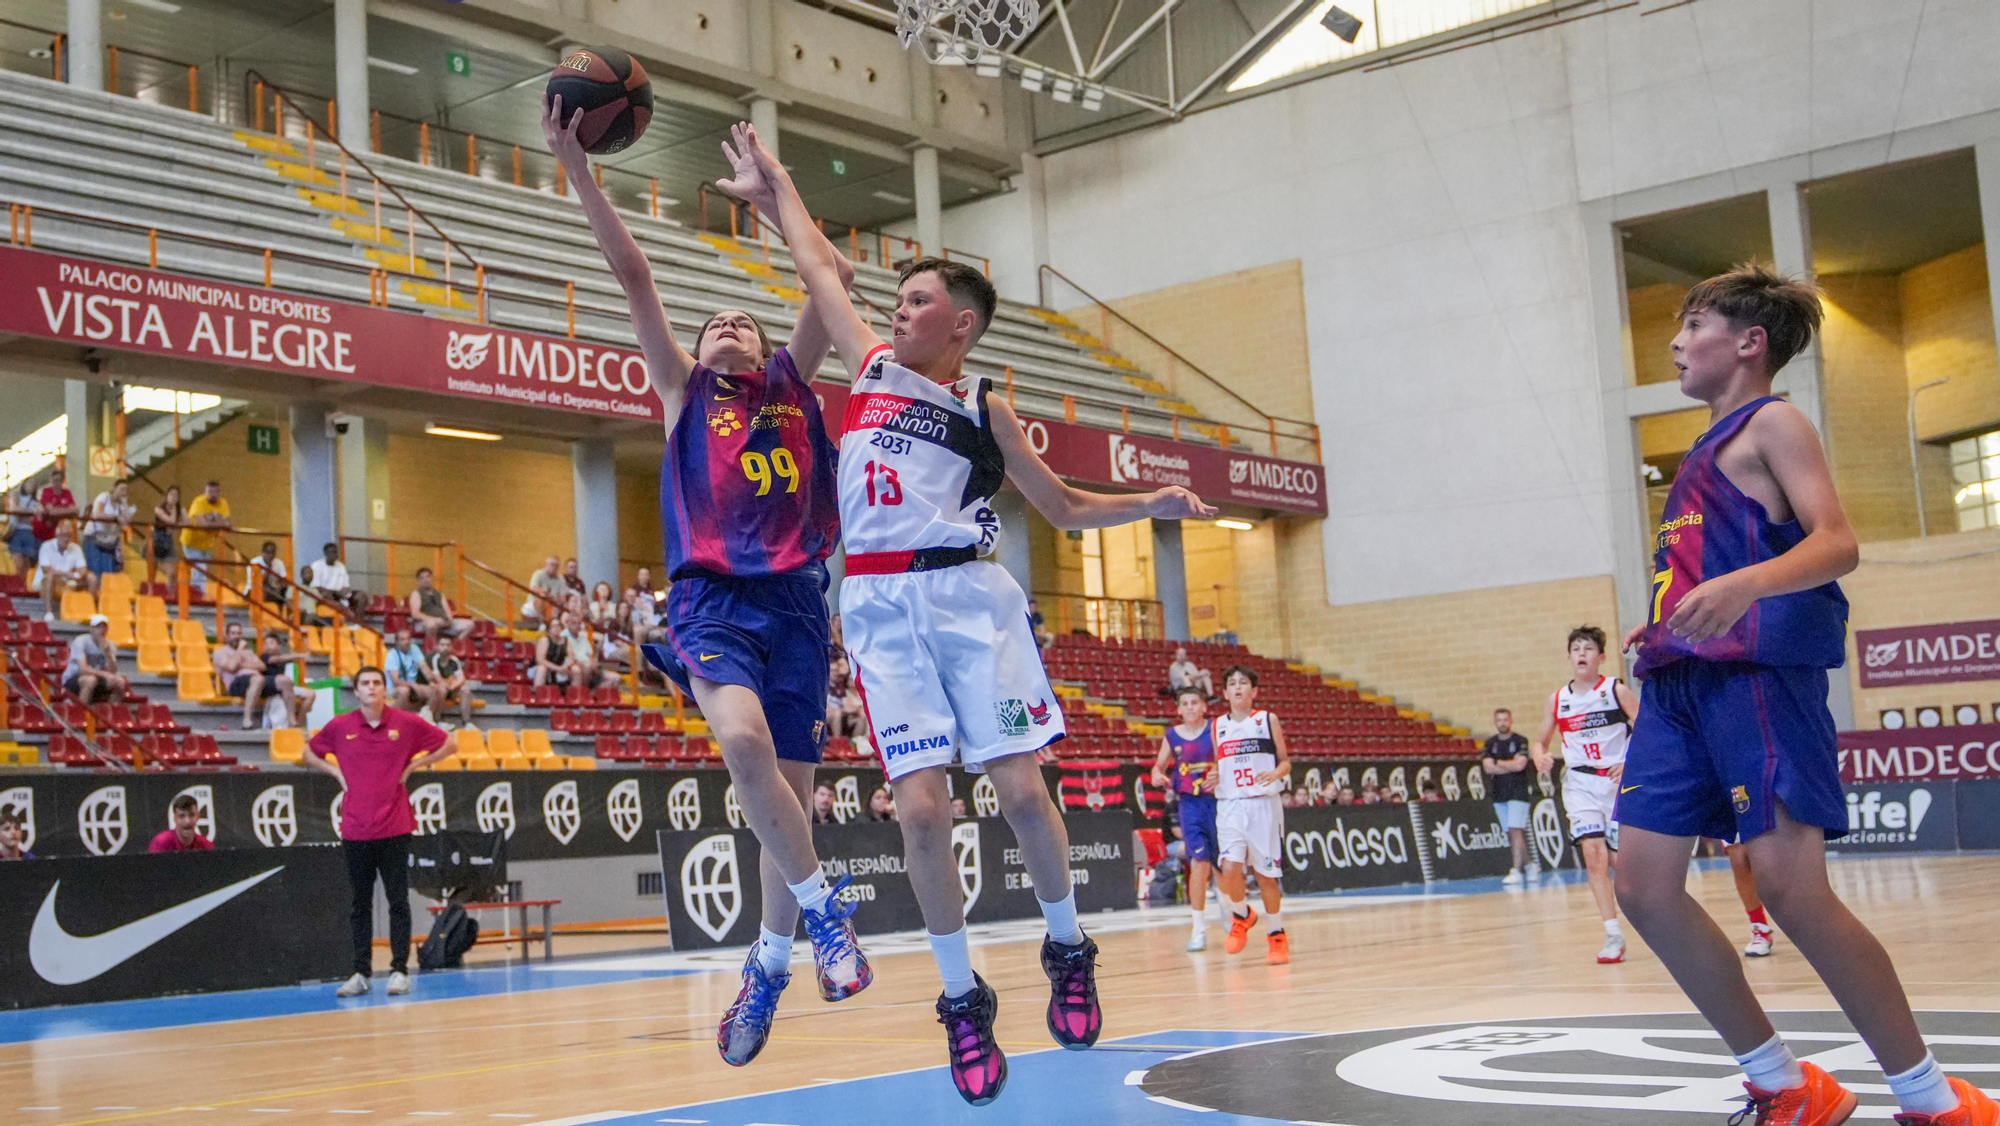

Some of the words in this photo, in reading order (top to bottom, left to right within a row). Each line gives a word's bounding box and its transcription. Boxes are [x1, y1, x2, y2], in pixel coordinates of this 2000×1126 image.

[453, 56, 464, 72] 9
[833, 160, 846, 174] 10
[59, 263, 143, 293] PALACIO
[147, 278, 244, 310] MUNICIPAL
[249, 294, 331, 323] DEPORTES
[37, 286, 173, 349] VISTA
[187, 311, 356, 373] ALEGRE
[496, 334, 651, 395] IMDECO
[447, 377, 493, 395] Instituto
[495, 383, 547, 403] Municipal
[548, 391, 562, 405] de
[563, 392, 609, 412] Deportes
[610, 399, 652, 416] Córdoba
[932, 410, 949, 422] CB
[256, 429, 271, 450] H
[869, 431, 913, 455] 2031
[1140, 449, 1190, 471] Diputación
[740, 447, 799, 497] 99
[864, 460, 903, 506] 13
[1249, 460, 1318, 494] IMDECO
[1904, 633, 2000, 664] IMDE
[880, 723, 910, 738] vive
[885, 735, 951, 760] PULEVA
[1233, 768, 1255, 788] 25
[12, 792, 29, 800] FEB
[105, 791, 121, 799] FEB
[1845, 788, 1932, 841] ife!
[961, 828, 975, 838] FEB
[1285, 817, 1408, 871] endesa
[1457, 822, 1511, 850] CaixaBa
[712, 841, 731, 852] FEB
[1069, 842, 1122, 861] ESPAÑOLA
[1005, 872, 1020, 889] DE
[1411, 1031, 1569, 1051] FEB
